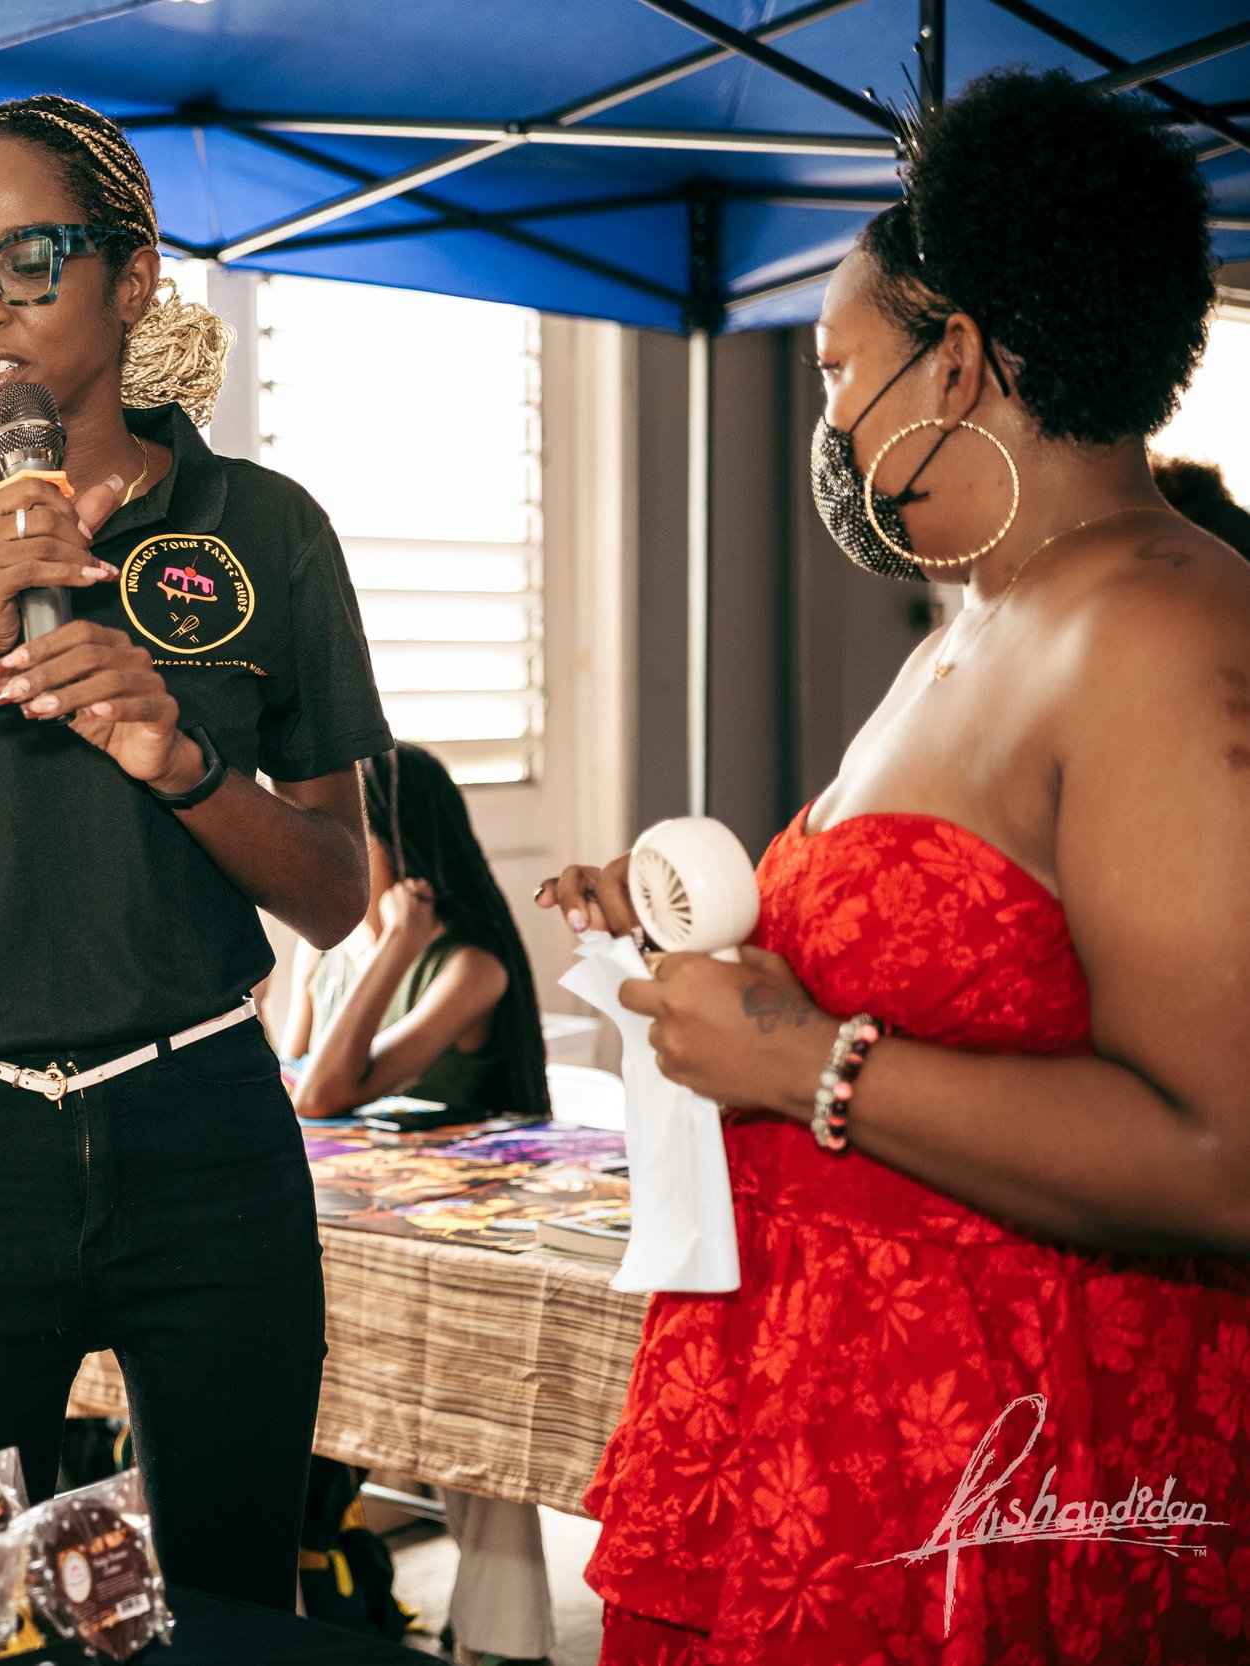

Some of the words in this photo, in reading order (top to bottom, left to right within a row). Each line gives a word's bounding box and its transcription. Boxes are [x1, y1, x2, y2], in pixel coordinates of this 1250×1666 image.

[159, 540, 199, 552] YOUR
[203, 541, 240, 577] TASTE
[233, 581, 248, 614] BUDS
[151, 659, 202, 667] UPCAKES
[215, 660, 248, 668] MUCH
